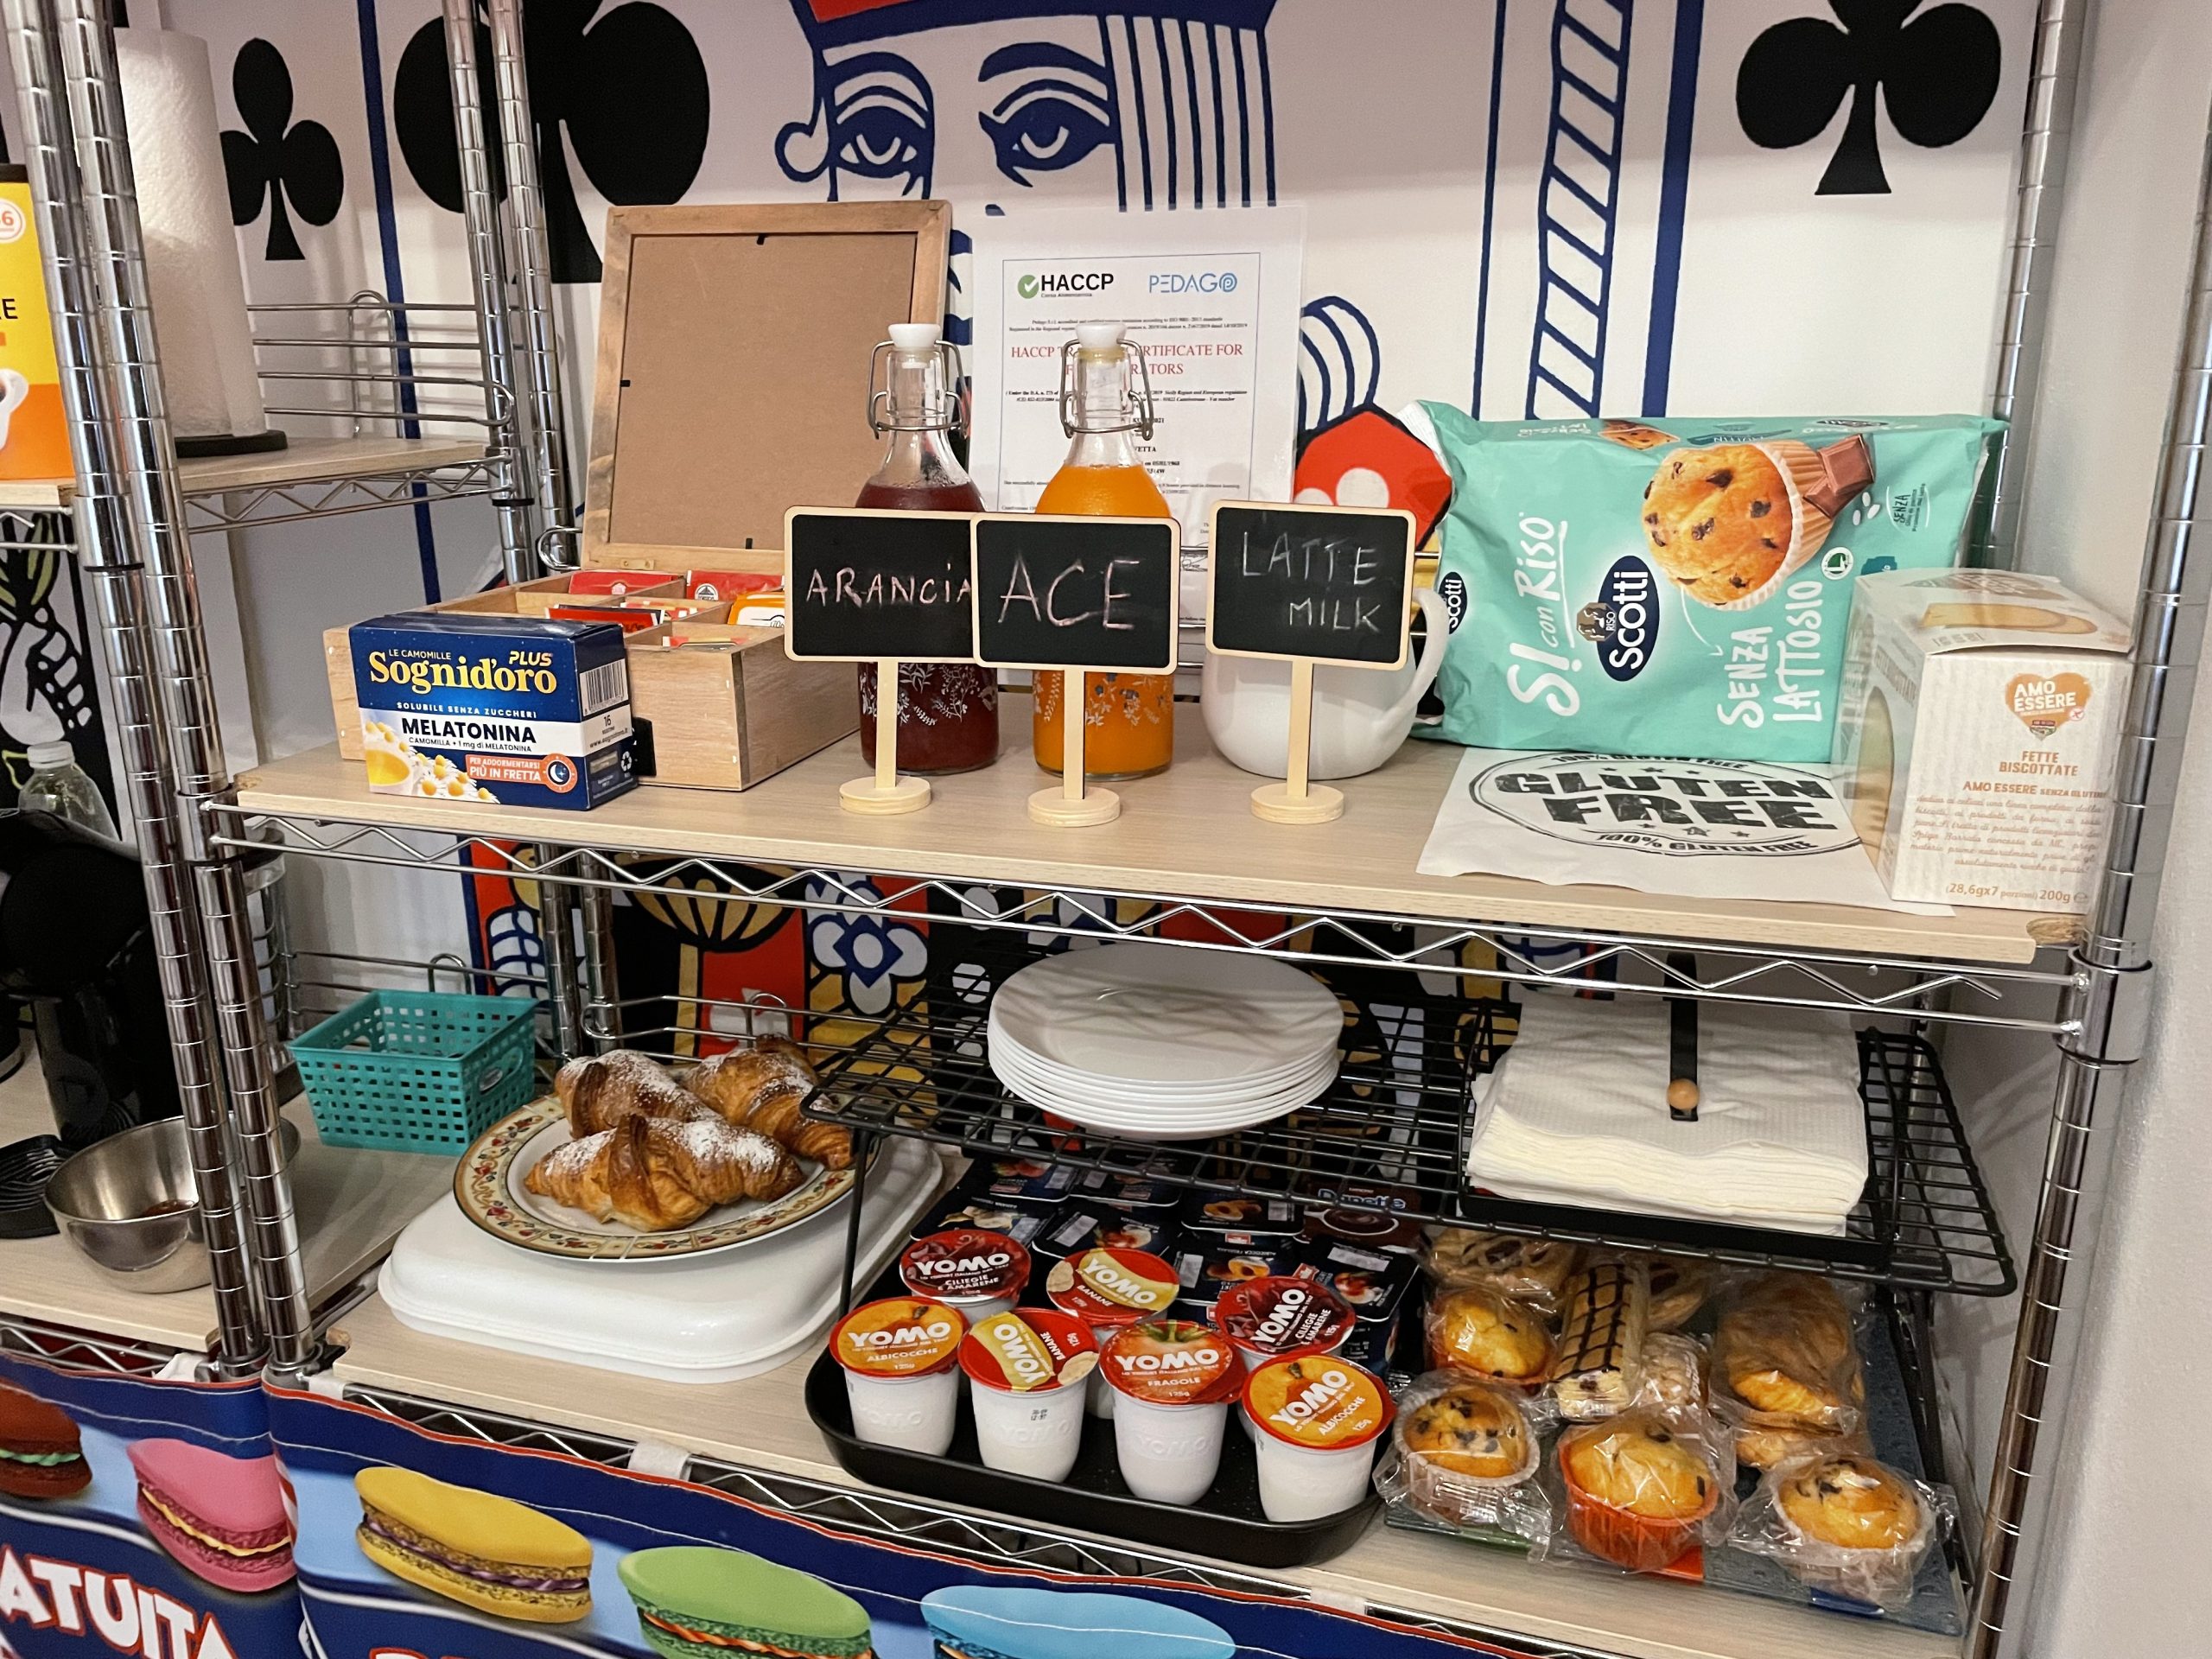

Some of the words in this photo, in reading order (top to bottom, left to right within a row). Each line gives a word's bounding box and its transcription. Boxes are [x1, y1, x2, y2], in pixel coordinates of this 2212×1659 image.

[1041, 273, 1114, 291] HACCP
[1011, 346, 1054, 358] HACCP
[1217, 344, 1243, 356] FOR
[1892, 494, 1910, 524] SENZA
[1243, 531, 1378, 585] LATTE
[997, 553, 1141, 630] ACE
[1289, 597, 1382, 632] MILK
[1605, 611, 1616, 632] RISO
[1608, 571, 1649, 670] Scotti
[1537, 607, 1559, 648] con
[401, 650, 452, 660] CAMOMILLE
[508, 650, 553, 667] PLUS
[1773, 581, 1825, 721] LATTOSIO
[1716, 626, 1773, 728] SENZA
[2014, 680, 2056, 698] AMO
[397, 702, 443, 713] SOLUBILE
[448, 705, 480, 715] SENZA
[485, 708, 537, 719] ZUCCHERI
[2014, 692, 2076, 712] ESSERE
[402, 717, 537, 743] MELATONINA
[603, 715, 612, 727] 16
[409, 737, 450, 747] CAMOMILLA
[485, 743, 532, 752] MELATONINA
[483, 759, 540, 770] ADDORMENTARSI
[2022, 751, 2059, 763] FETTE
[469, 763, 486, 777] PIÙ
[489, 769, 500, 778] IN
[504, 770, 543, 782] FRETTA
[1999, 761, 2079, 777] BISCOTTATE
[1495, 772, 1834, 799] GLUTEN
[1963, 781, 1991, 791] AMO
[1994, 783, 2037, 795] ESSERE
[1542, 793, 1838, 830] FREE
[1597, 833, 1662, 849] 100%
[1669, 842, 1764, 853] GLUTEN
[1762, 841, 1819, 852] FREE
[2039, 889, 2071, 903] 200g
[913, 1253, 1010, 1275] YOMO
[945, 1274, 989, 1287] CILIEGIE
[947, 1277, 1000, 1291] AMARENE
[1084, 1258, 1157, 1304] YOMO
[1077, 1285, 1116, 1306] BANANE
[1249, 1288, 1306, 1344] YOMO
[1295, 1313, 1319, 1339] CILIEGIE
[1305, 1308, 1332, 1341] AMARENE
[848, 1322, 950, 1348] YOMO
[867, 1348, 938, 1363] ALBICOCCHE
[994, 1324, 1046, 1383] YOMO
[1040, 1331, 1066, 1361] BANANE
[1114, 1348, 1219, 1371] YOMO
[1147, 1377, 1201, 1387] FRAGOLE
[1269, 1370, 1348, 1426] YOMO
[1318, 1396, 1366, 1436] ALBICOCCHE
